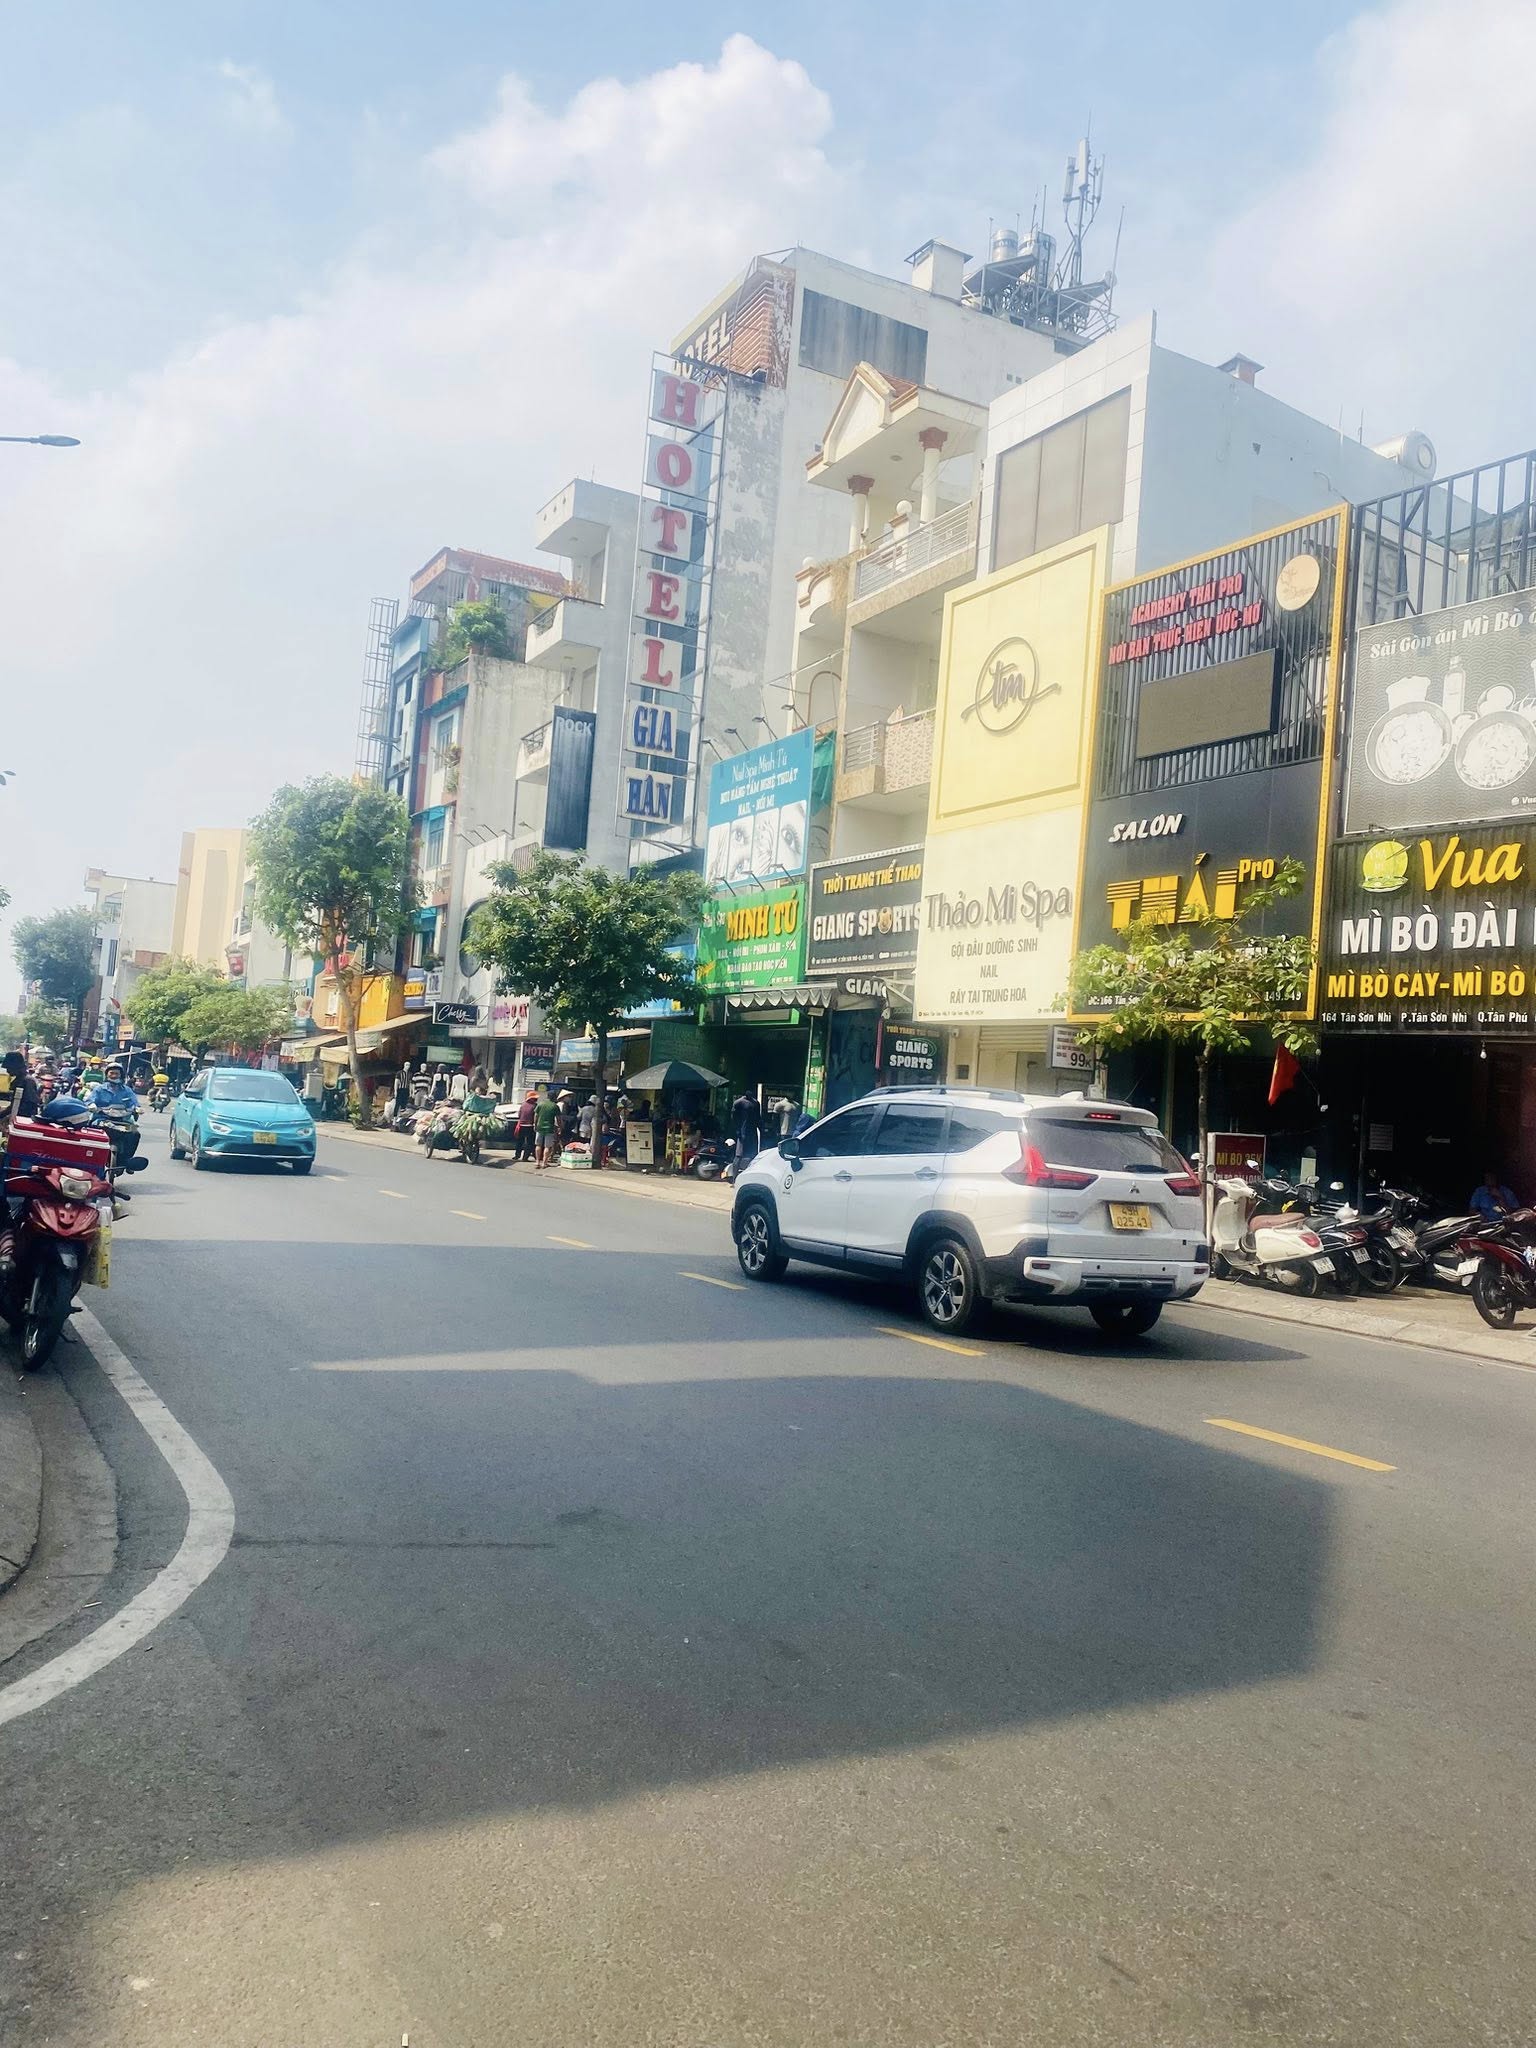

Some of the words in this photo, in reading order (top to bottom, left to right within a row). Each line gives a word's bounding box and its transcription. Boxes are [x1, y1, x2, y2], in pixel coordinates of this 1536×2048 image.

[640, 375, 701, 687] HOTEL
[1370, 639, 1397, 659] Sài
[1400, 634, 1432, 653] Gòn
[1434, 628, 1457, 645] ăn
[1461, 614, 1490, 639] Mì
[1494, 607, 1524, 632] Bò
[632, 704, 673, 753] GIA
[1107, 813, 1183, 843] SALON
[822, 872, 844, 895] THỜI
[844, 870, 875, 891] TRANG
[875, 858, 896, 886] THỂ
[895, 863, 922, 883] THAO
[1419, 835, 1525, 891] Vua
[726, 904, 770, 942] MINH
[773, 889, 799, 936] TÚ
[925, 890, 982, 929] Thảo
[1020, 880, 1072, 928] Spa
[813, 911, 857, 942] GIANG
[1340, 908, 1383, 955] MÌ
[1390, 904, 1439, 953] BÒ
[1451, 901, 1518, 949] ĐÀI
[1017, 937, 1038, 953] SINH
[979, 964, 999, 979] NAIL
[1327, 969, 1355, 998] MÌ
[1359, 968, 1389, 998] BÒ
[1490, 964, 1526, 998] BÒ
[968, 989, 981, 1004] TAI
[981, 987, 1009, 1003] TRUNG
[1009, 987, 1027, 1002] HOA
[1321, 1012, 1337, 1023] 164
[1340, 1011, 1356, 1023] Tân
[1358, 1012, 1374, 1023] Sơn
[1377, 1011, 1392, 1023] Nhì
[1430, 1011, 1448, 1023] Sơn
[1451, 1010, 1468, 1023] Nhì
[1508, 1011, 1528, 1023] Phú
[523, 1044, 554, 1058] HOTEL
[889, 1054, 933, 1070] SPORTS
[895, 1040, 929, 1055] GIANG
